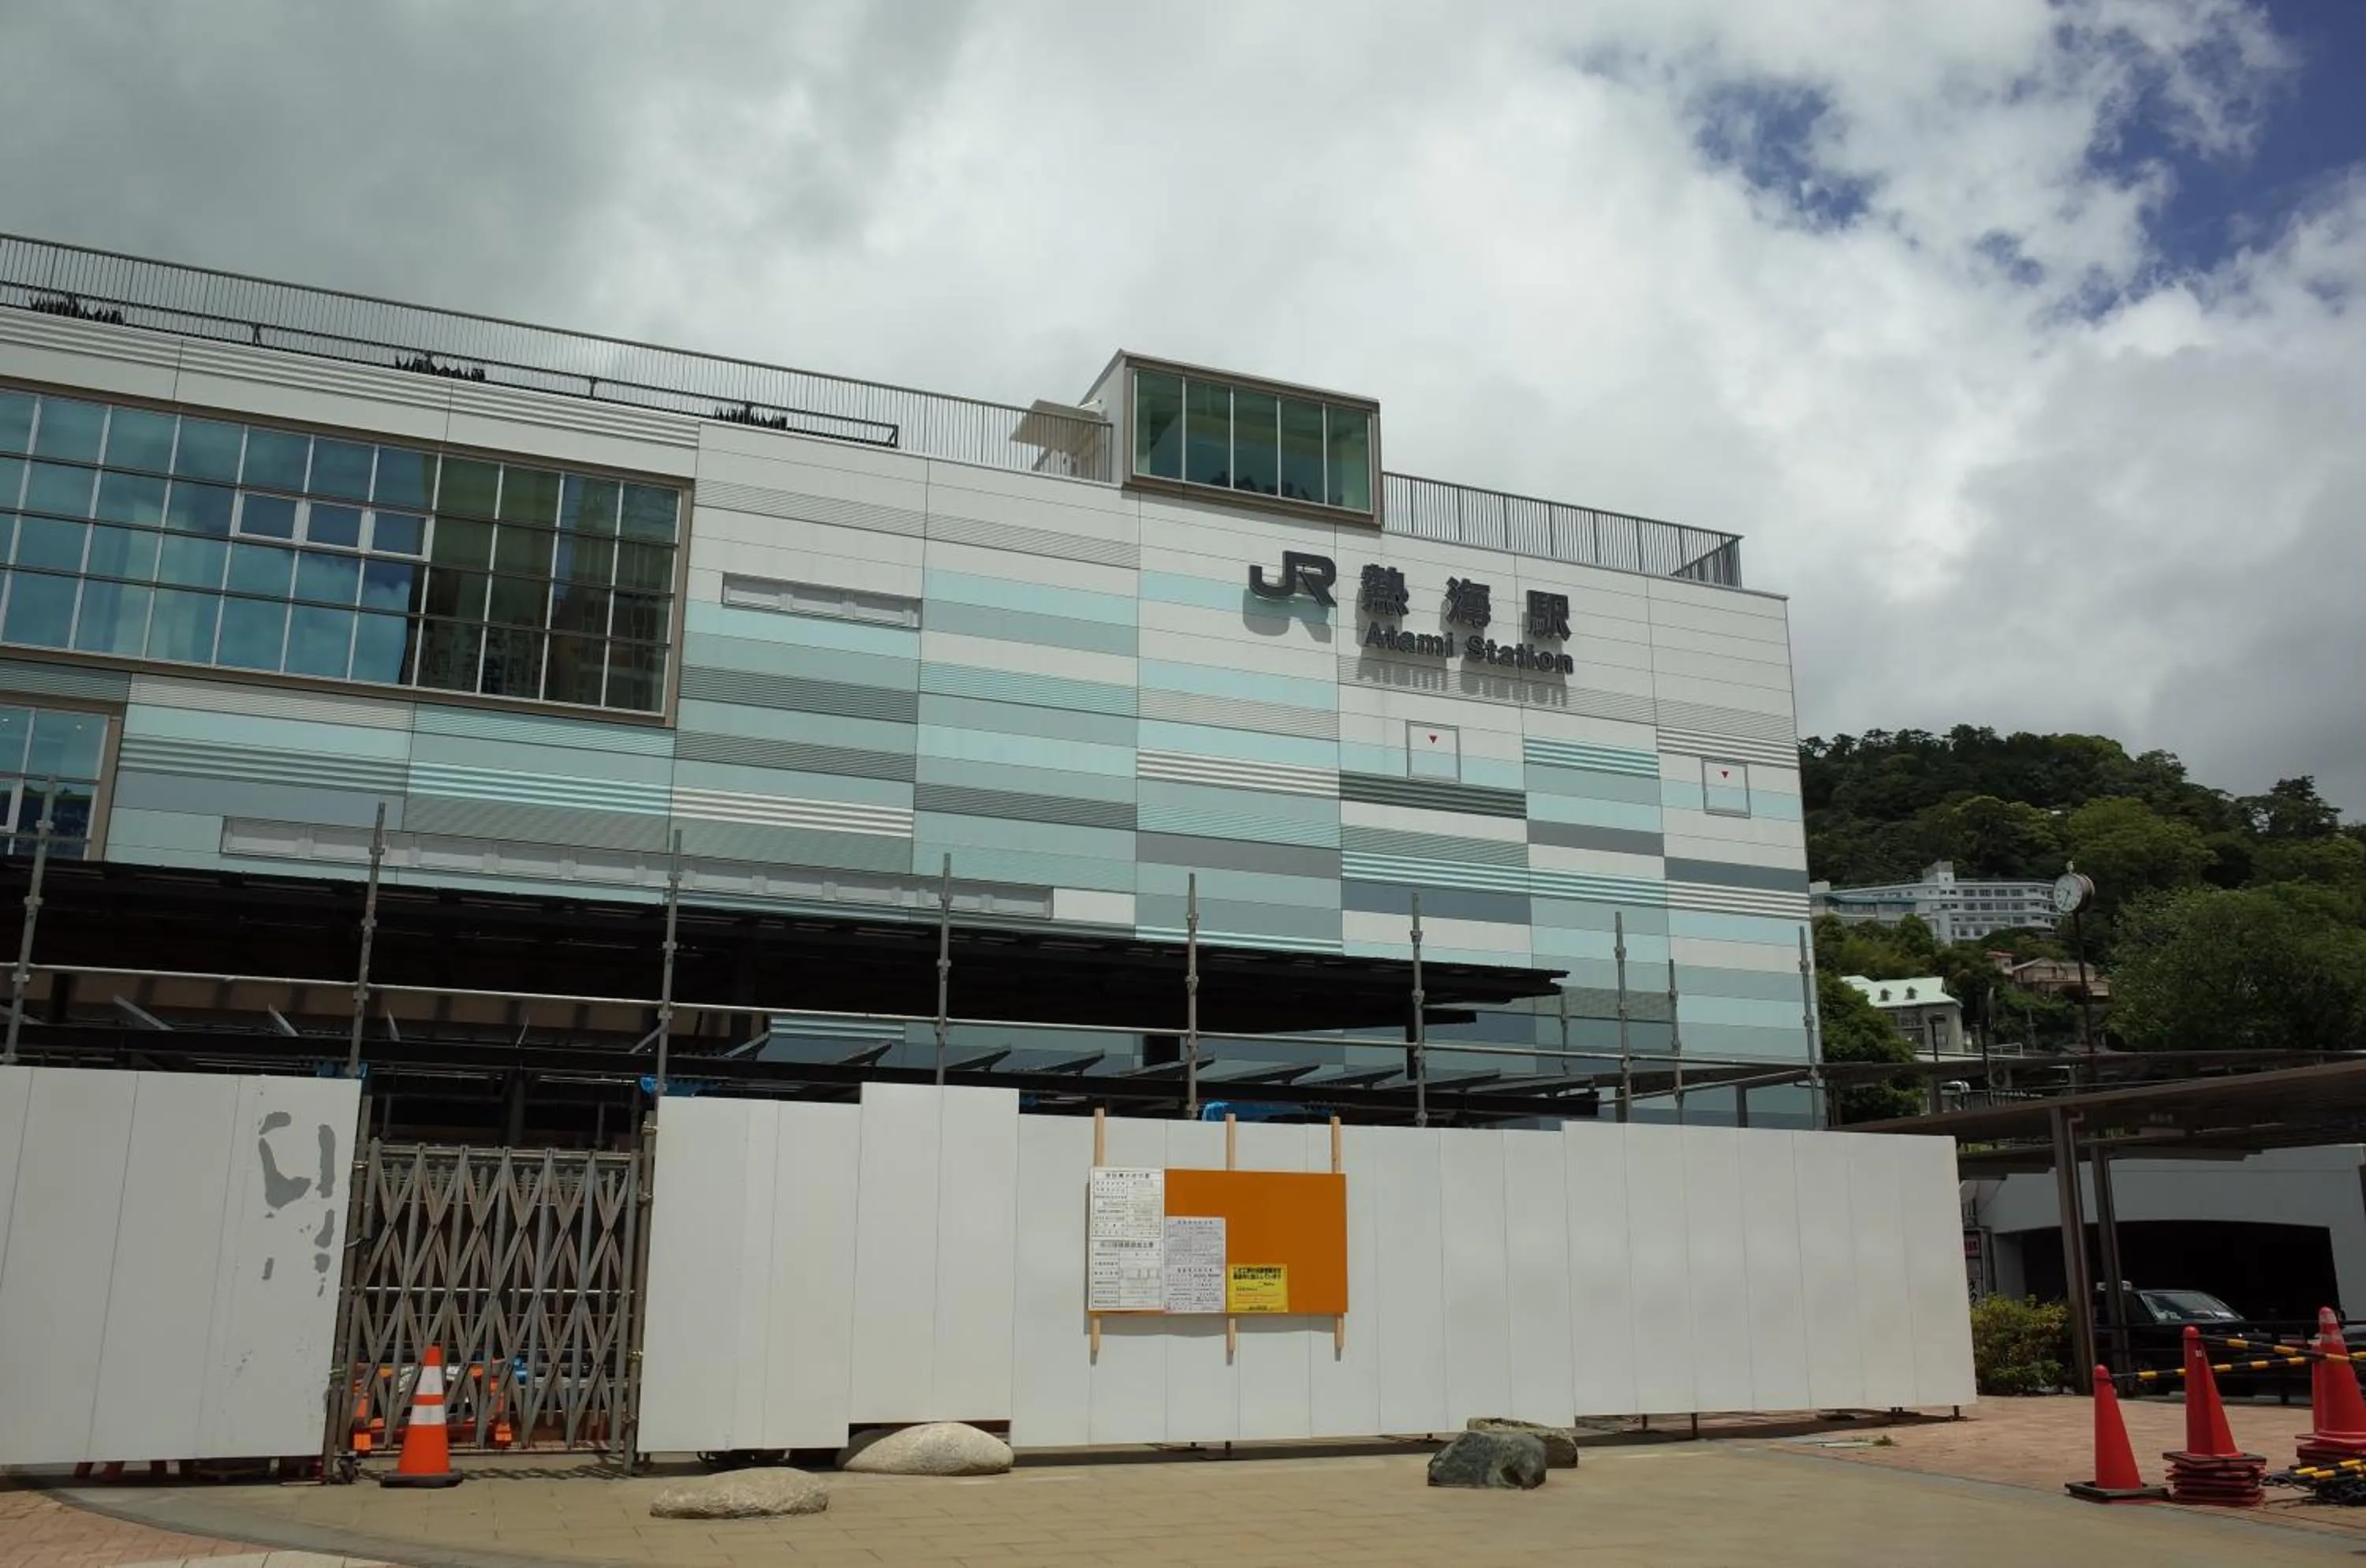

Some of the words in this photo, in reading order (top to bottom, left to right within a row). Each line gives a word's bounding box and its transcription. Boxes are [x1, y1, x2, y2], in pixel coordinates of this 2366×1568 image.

[1248, 550, 1337, 607] JR
[1360, 563, 1572, 642] 熱海駅
[1364, 621, 1454, 659] Atami
[1465, 635, 1574, 675] Station
